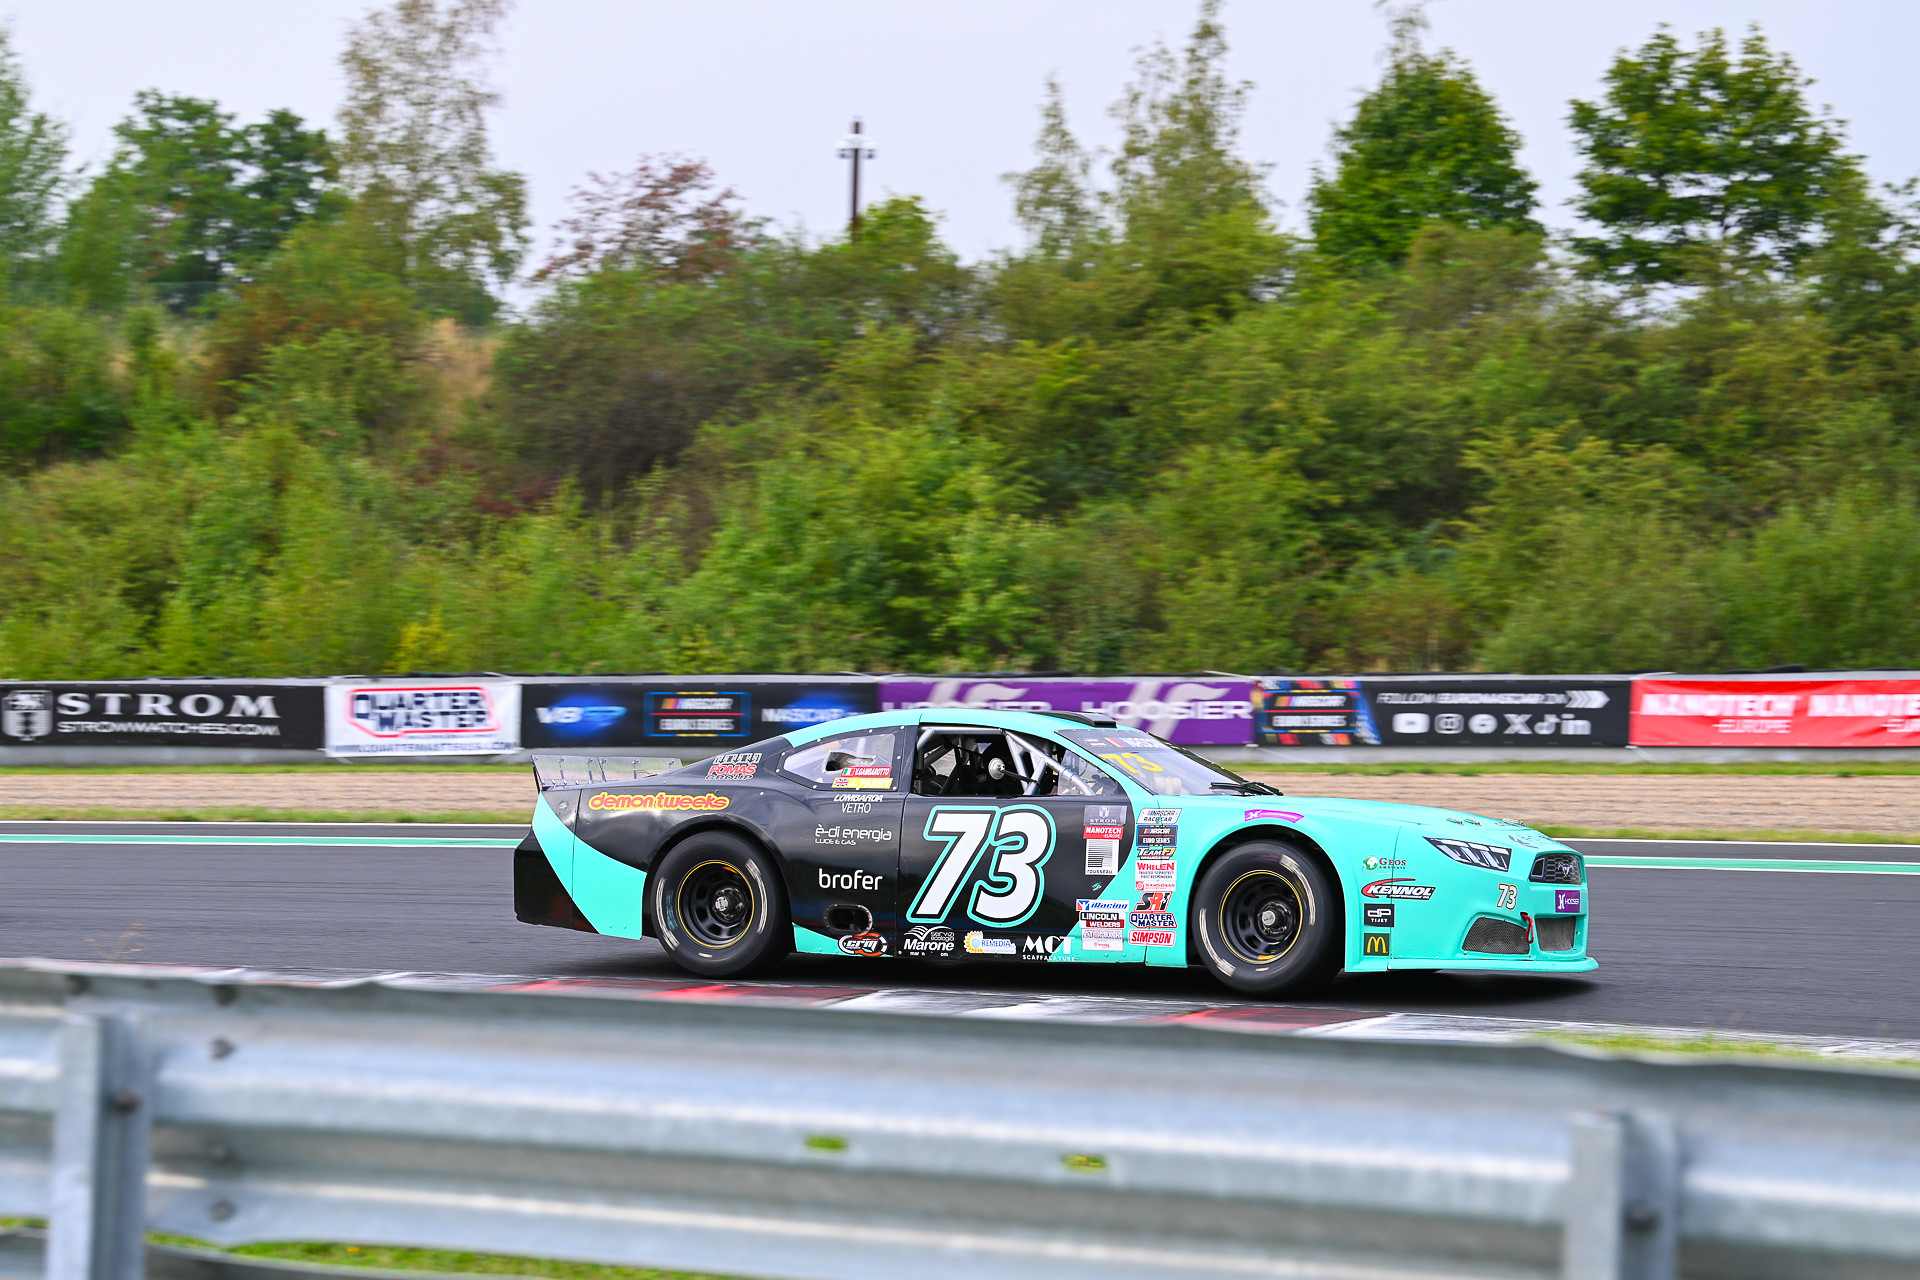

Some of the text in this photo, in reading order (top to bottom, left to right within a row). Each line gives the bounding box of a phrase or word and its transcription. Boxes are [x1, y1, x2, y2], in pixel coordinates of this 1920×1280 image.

[56, 692, 281, 718] STROM
[354, 692, 484, 719] QUARTER
[1081, 701, 1254, 719] HOOSIER
[1640, 694, 1800, 715] NANOTECH
[377, 711, 488, 731] MASTER
[1098, 752, 1164, 774] 73
[833, 794, 884, 803] LOMBARDA
[841, 802, 872, 814] VETRO
[842, 827, 892, 842] energia
[1085, 826, 1122, 834] NANOTECH
[908, 806, 1055, 925] 73
[818, 867, 883, 891] brofer
[1366, 885, 1432, 896] KENNOL
[1496, 883, 1519, 911] 73
[1091, 902, 1128, 910] iRacing
[1130, 913, 1173, 922] QUARTER
[903, 939, 955, 951] Marone
[981, 939, 1011, 947] REMEDIA
[1022, 935, 1076, 954] MCT
[1131, 931, 1172, 944] SIMPSON
